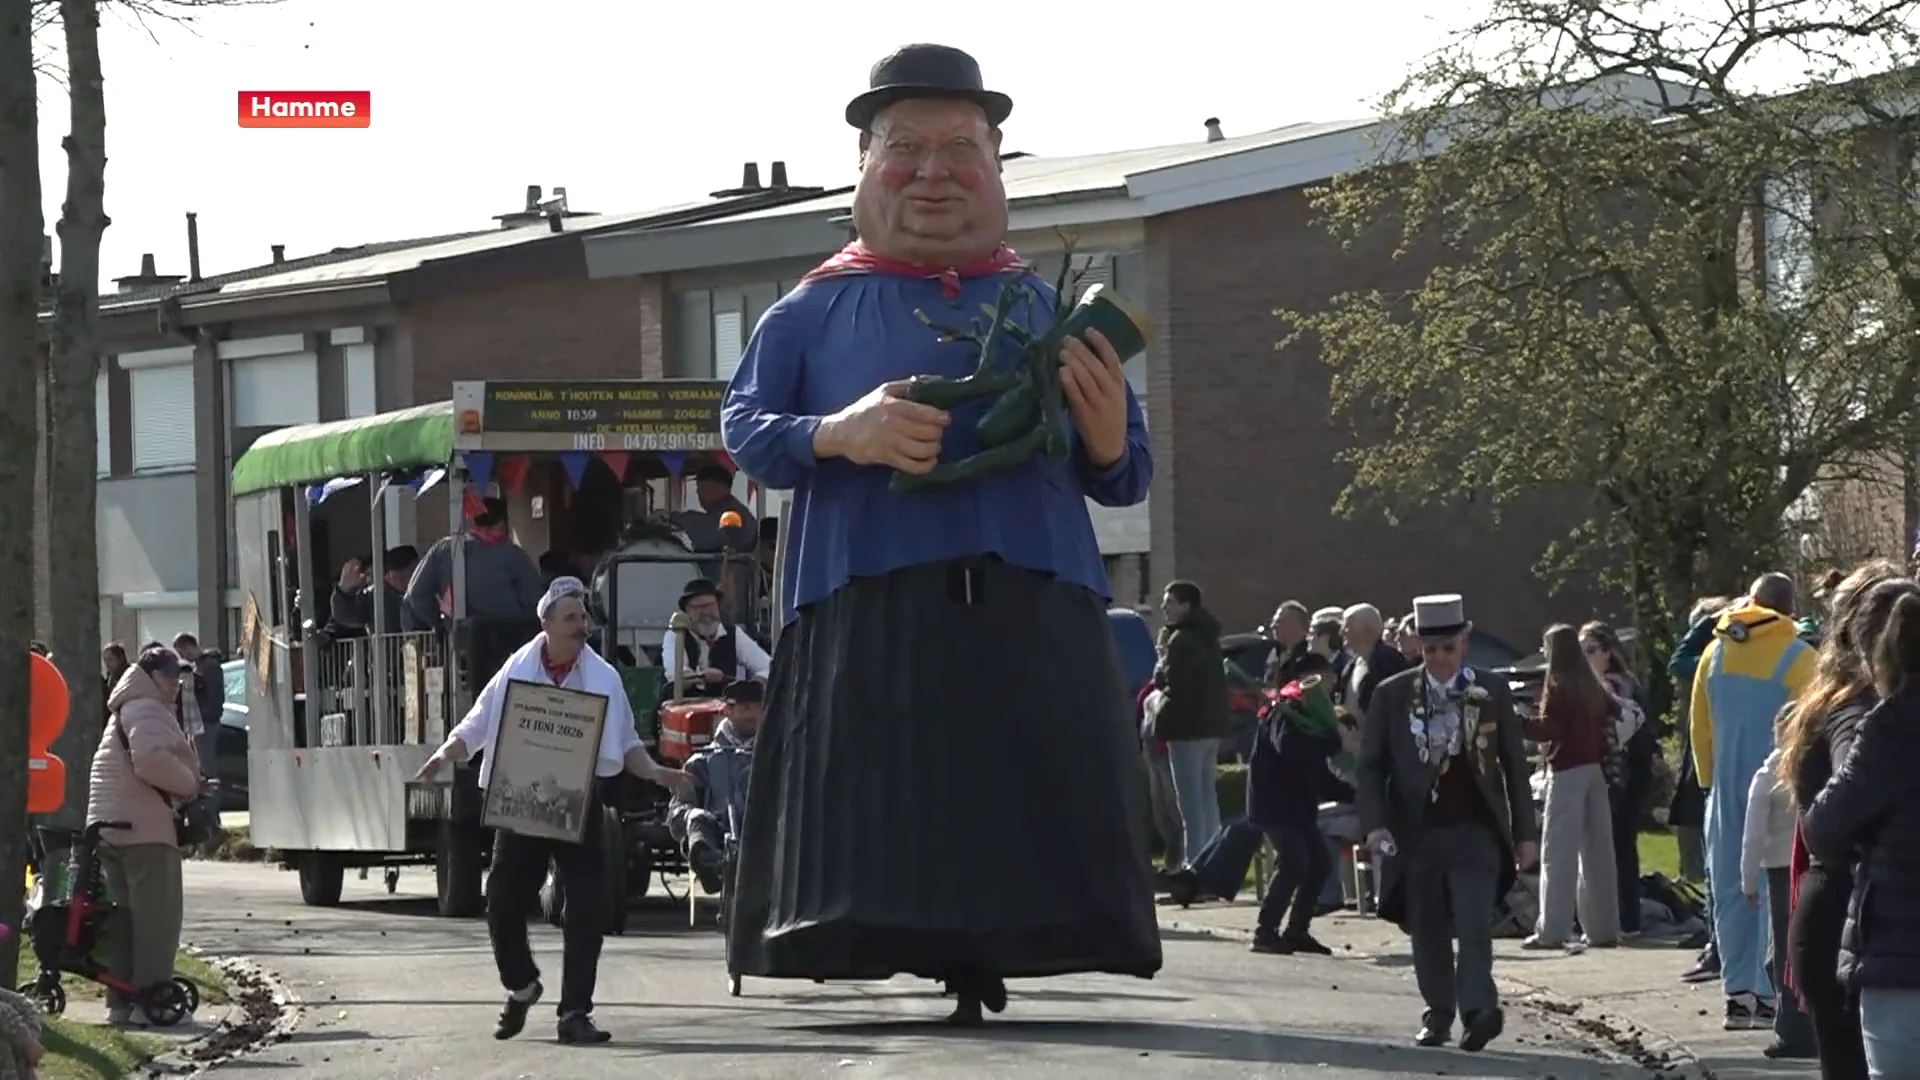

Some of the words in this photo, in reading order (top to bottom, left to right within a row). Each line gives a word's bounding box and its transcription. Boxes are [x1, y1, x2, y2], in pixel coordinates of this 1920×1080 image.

[530, 410, 561, 420] ANNO
[566, 409, 598, 420] 1839
[623, 409, 663, 420] HAMME
[574, 433, 605, 450] INFO
[518, 718, 531, 729] 21
[533, 720, 554, 733] JUNI
[556, 725, 583, 738] 2026
